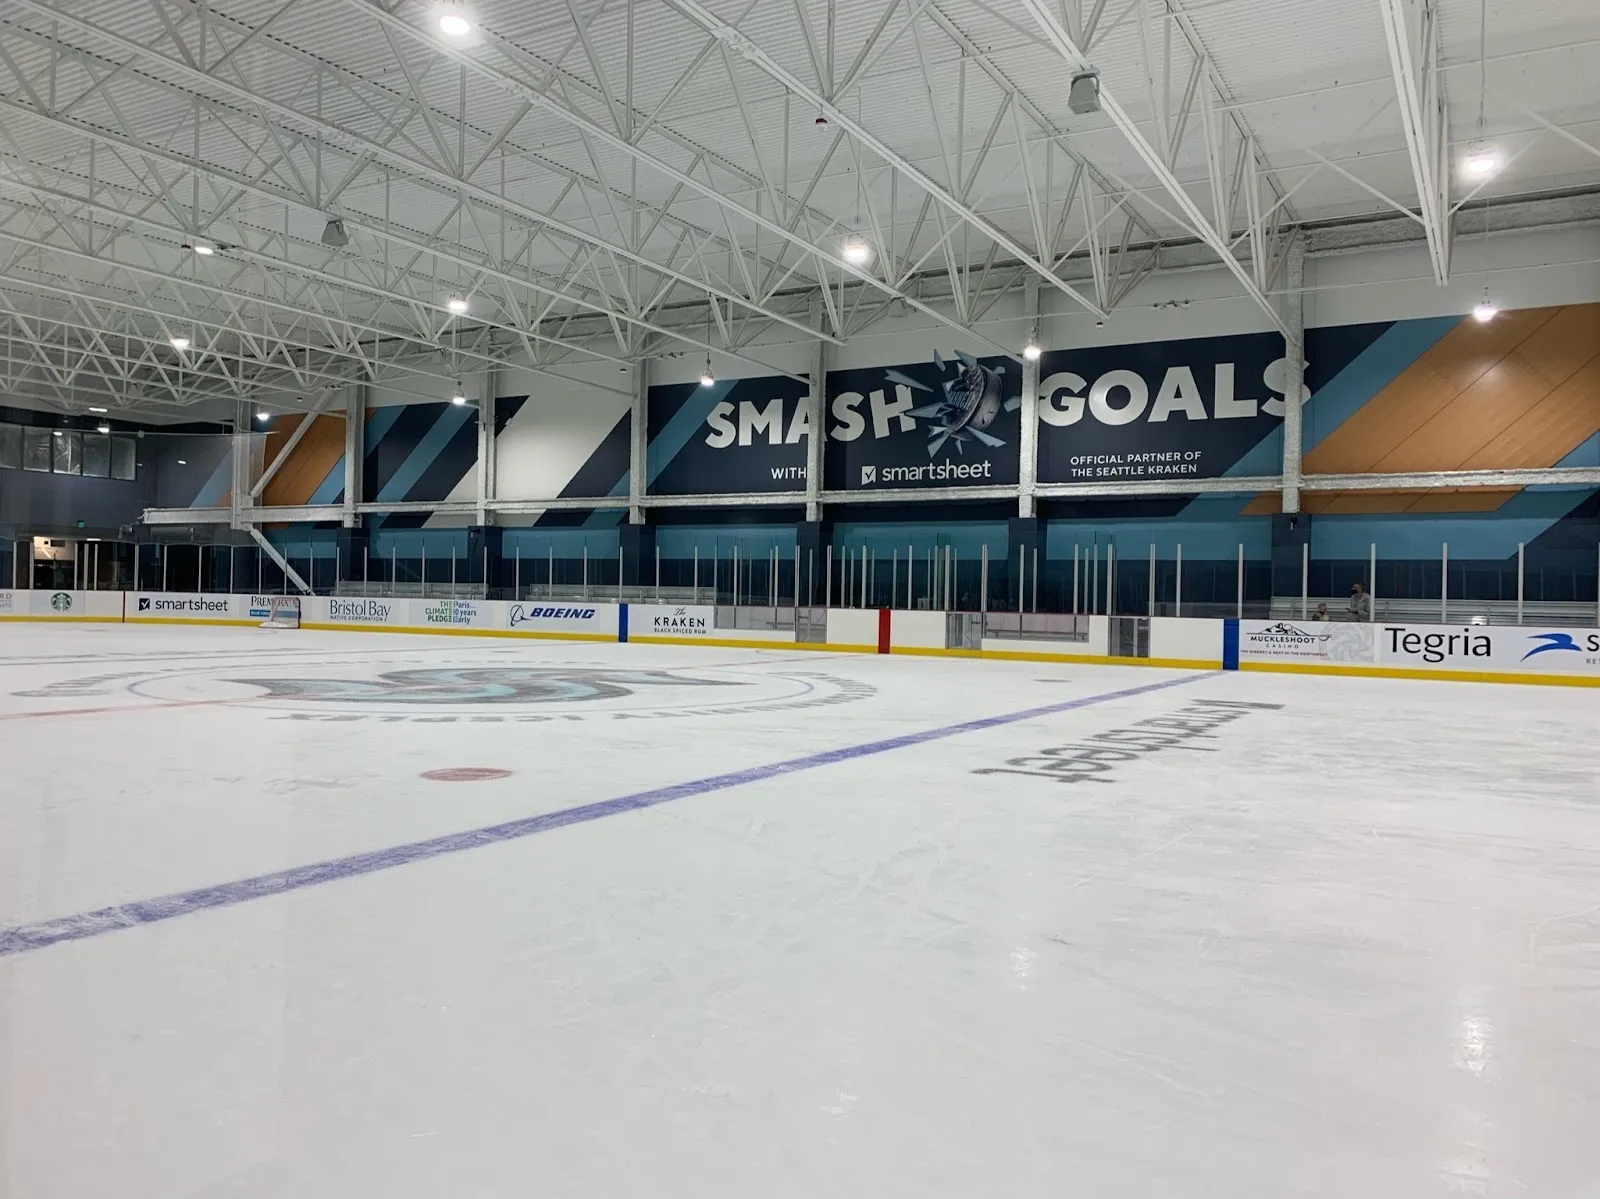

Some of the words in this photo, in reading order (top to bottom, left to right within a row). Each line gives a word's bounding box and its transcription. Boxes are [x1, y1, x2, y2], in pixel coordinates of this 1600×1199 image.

[705, 384, 917, 449] SMASH
[1038, 357, 1311, 427] GOALS
[1070, 455, 1124, 465] OFFICIAL
[1127, 452, 1181, 463] PARTNER
[1184, 451, 1202, 460] OF
[771, 467, 807, 479] WITH
[882, 459, 992, 481] smartsheet
[1071, 468, 1093, 477] THE
[1096, 466, 1145, 477] SEATTLE
[1148, 464, 1197, 474] KRAKEN
[155, 597, 229, 612] smartsheet
[330, 600, 367, 616] Bristol
[368, 600, 392, 622] Bay
[460, 609, 477, 617] years
[530, 607, 596, 619] BOEING
[654, 616, 705, 627] KRAKEN
[1250, 635, 1316, 643] MUCKLESHOOT
[1385, 627, 1491, 663] Tegria
